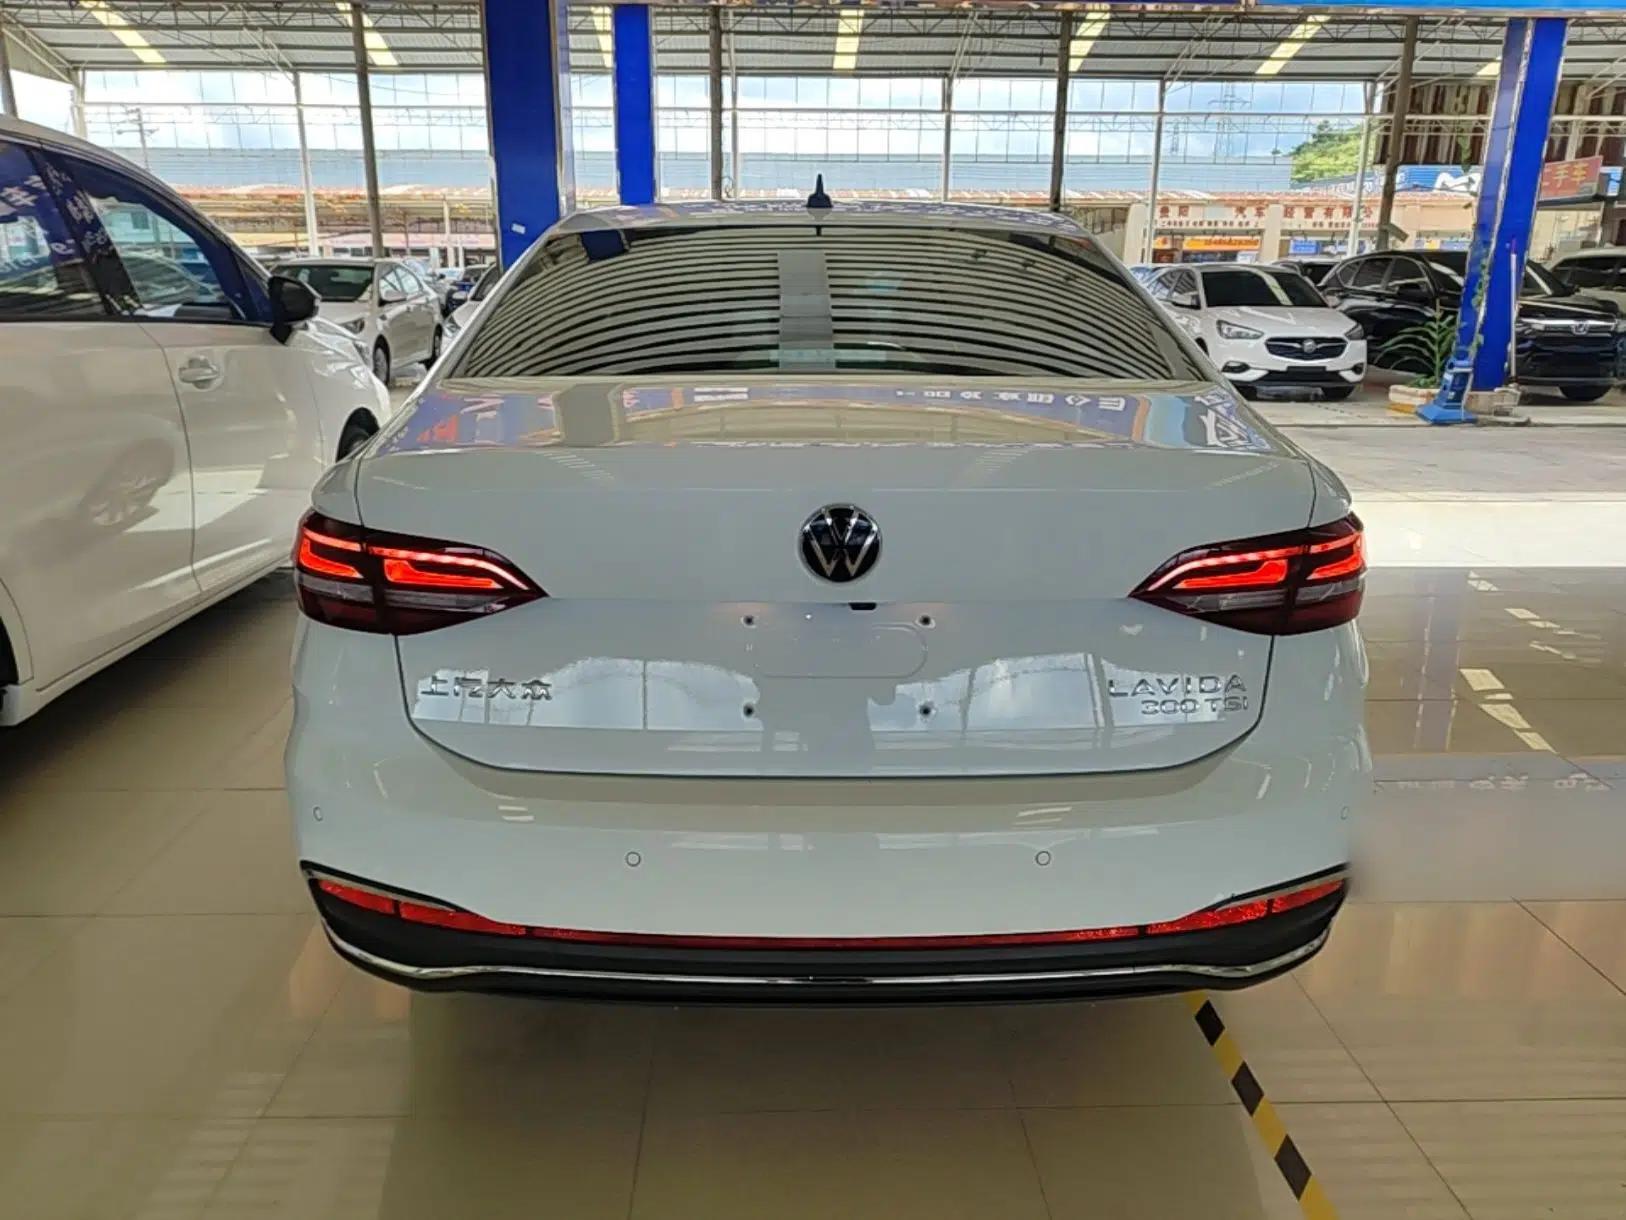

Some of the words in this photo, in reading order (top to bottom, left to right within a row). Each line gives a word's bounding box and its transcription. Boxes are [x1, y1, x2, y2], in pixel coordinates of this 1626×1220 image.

[420, 675, 552, 701] 上汽大众
[1108, 674, 1247, 697] LAVIDA
